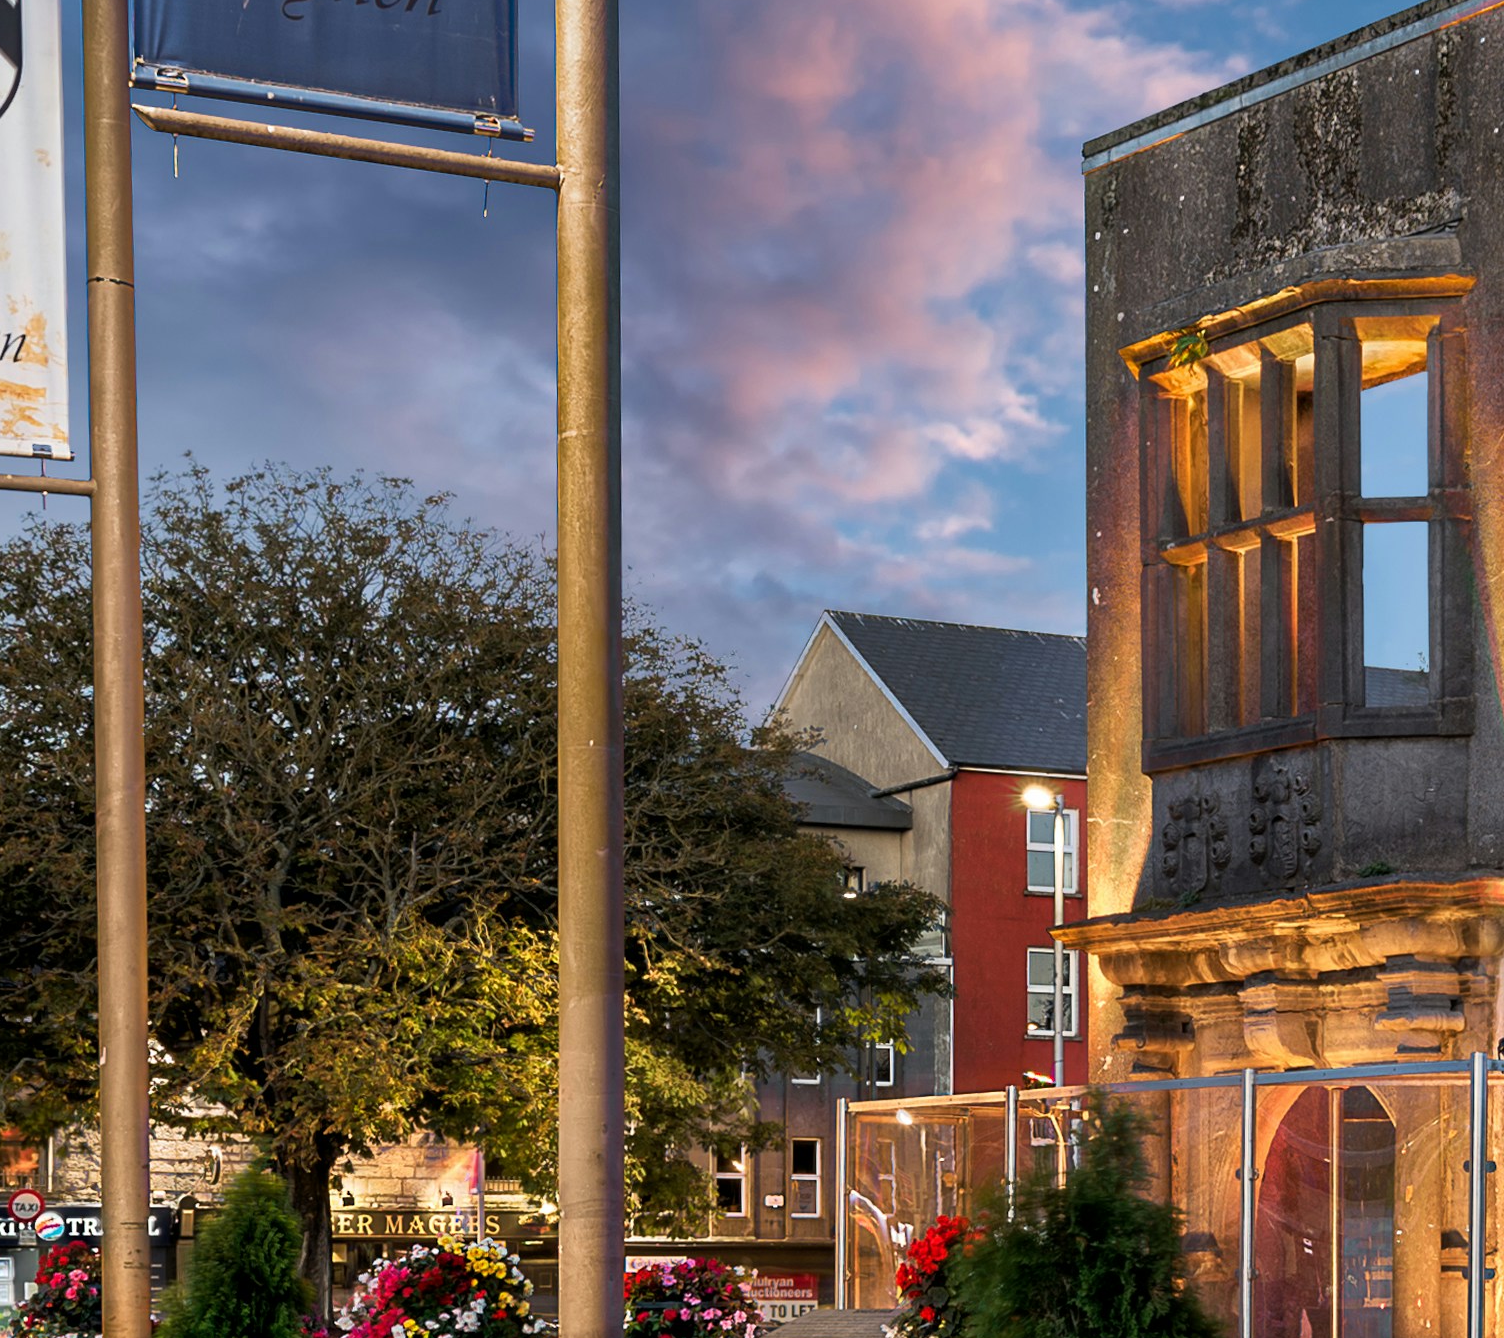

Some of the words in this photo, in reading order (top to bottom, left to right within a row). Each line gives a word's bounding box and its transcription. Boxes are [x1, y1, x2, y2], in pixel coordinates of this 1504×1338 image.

[14, 1202, 39, 1213] TAXI
[385, 1215, 501, 1235] MAGEES
[770, 1305, 786, 1318] TO
